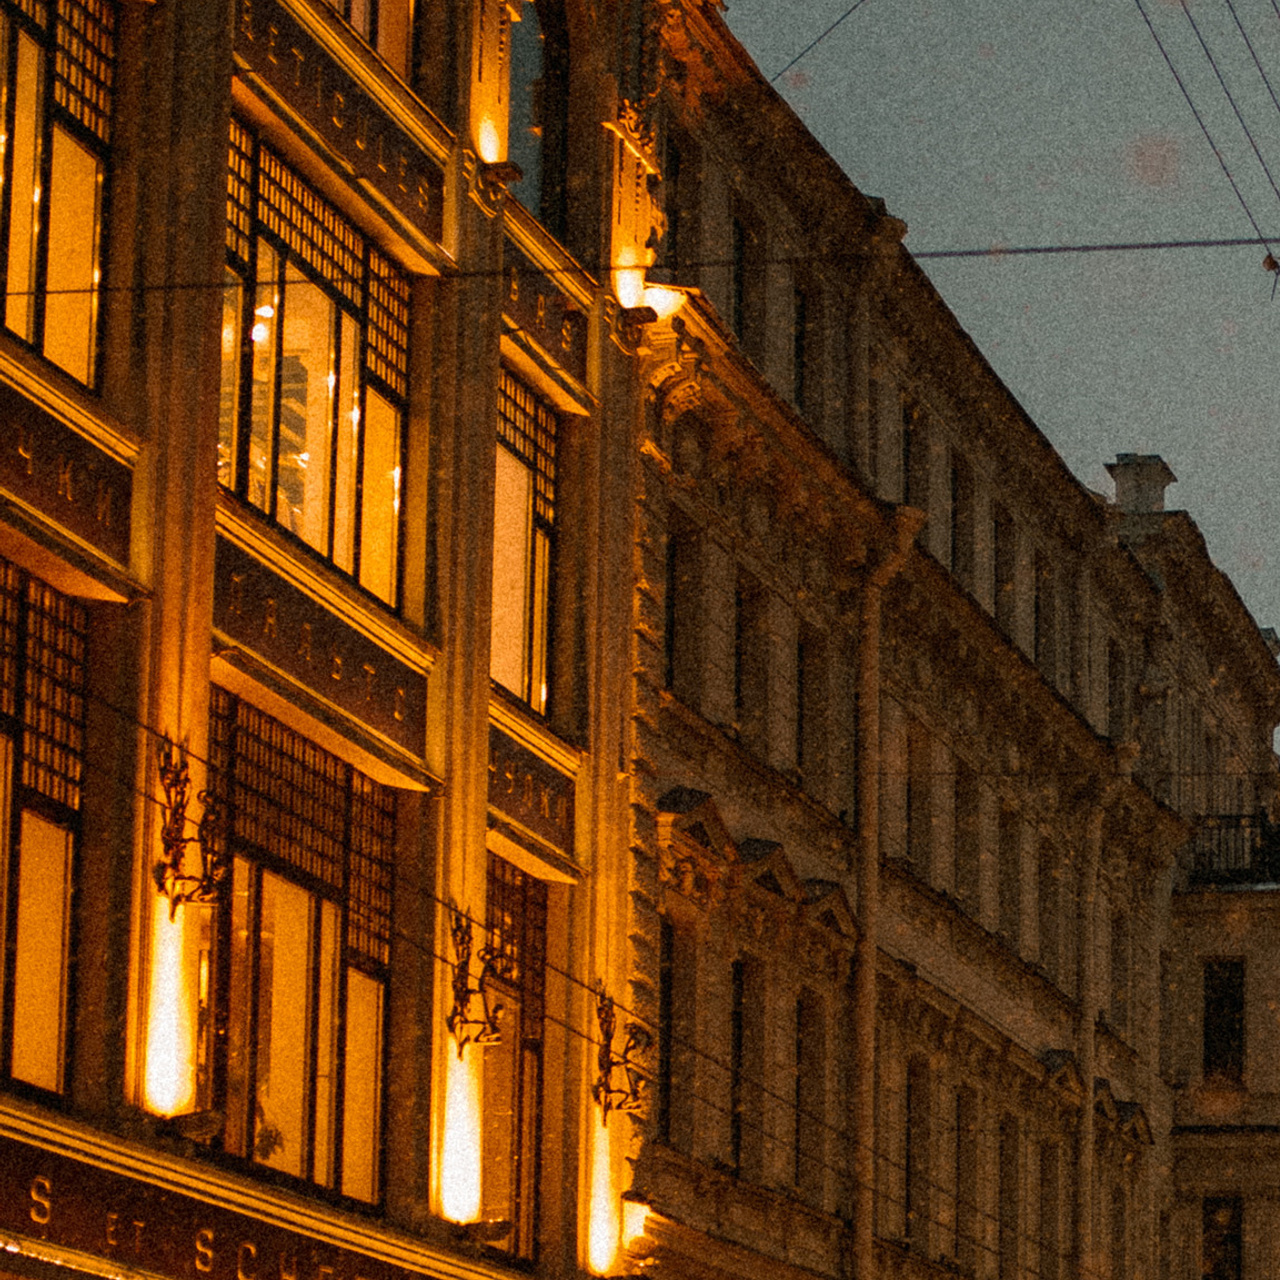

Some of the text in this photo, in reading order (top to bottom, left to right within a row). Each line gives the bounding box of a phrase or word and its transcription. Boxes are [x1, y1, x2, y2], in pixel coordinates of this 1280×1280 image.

[508, 264, 573, 352] BAS
[28, 1174, 53, 1225] S
[106, 1212, 147, 1254] ET
